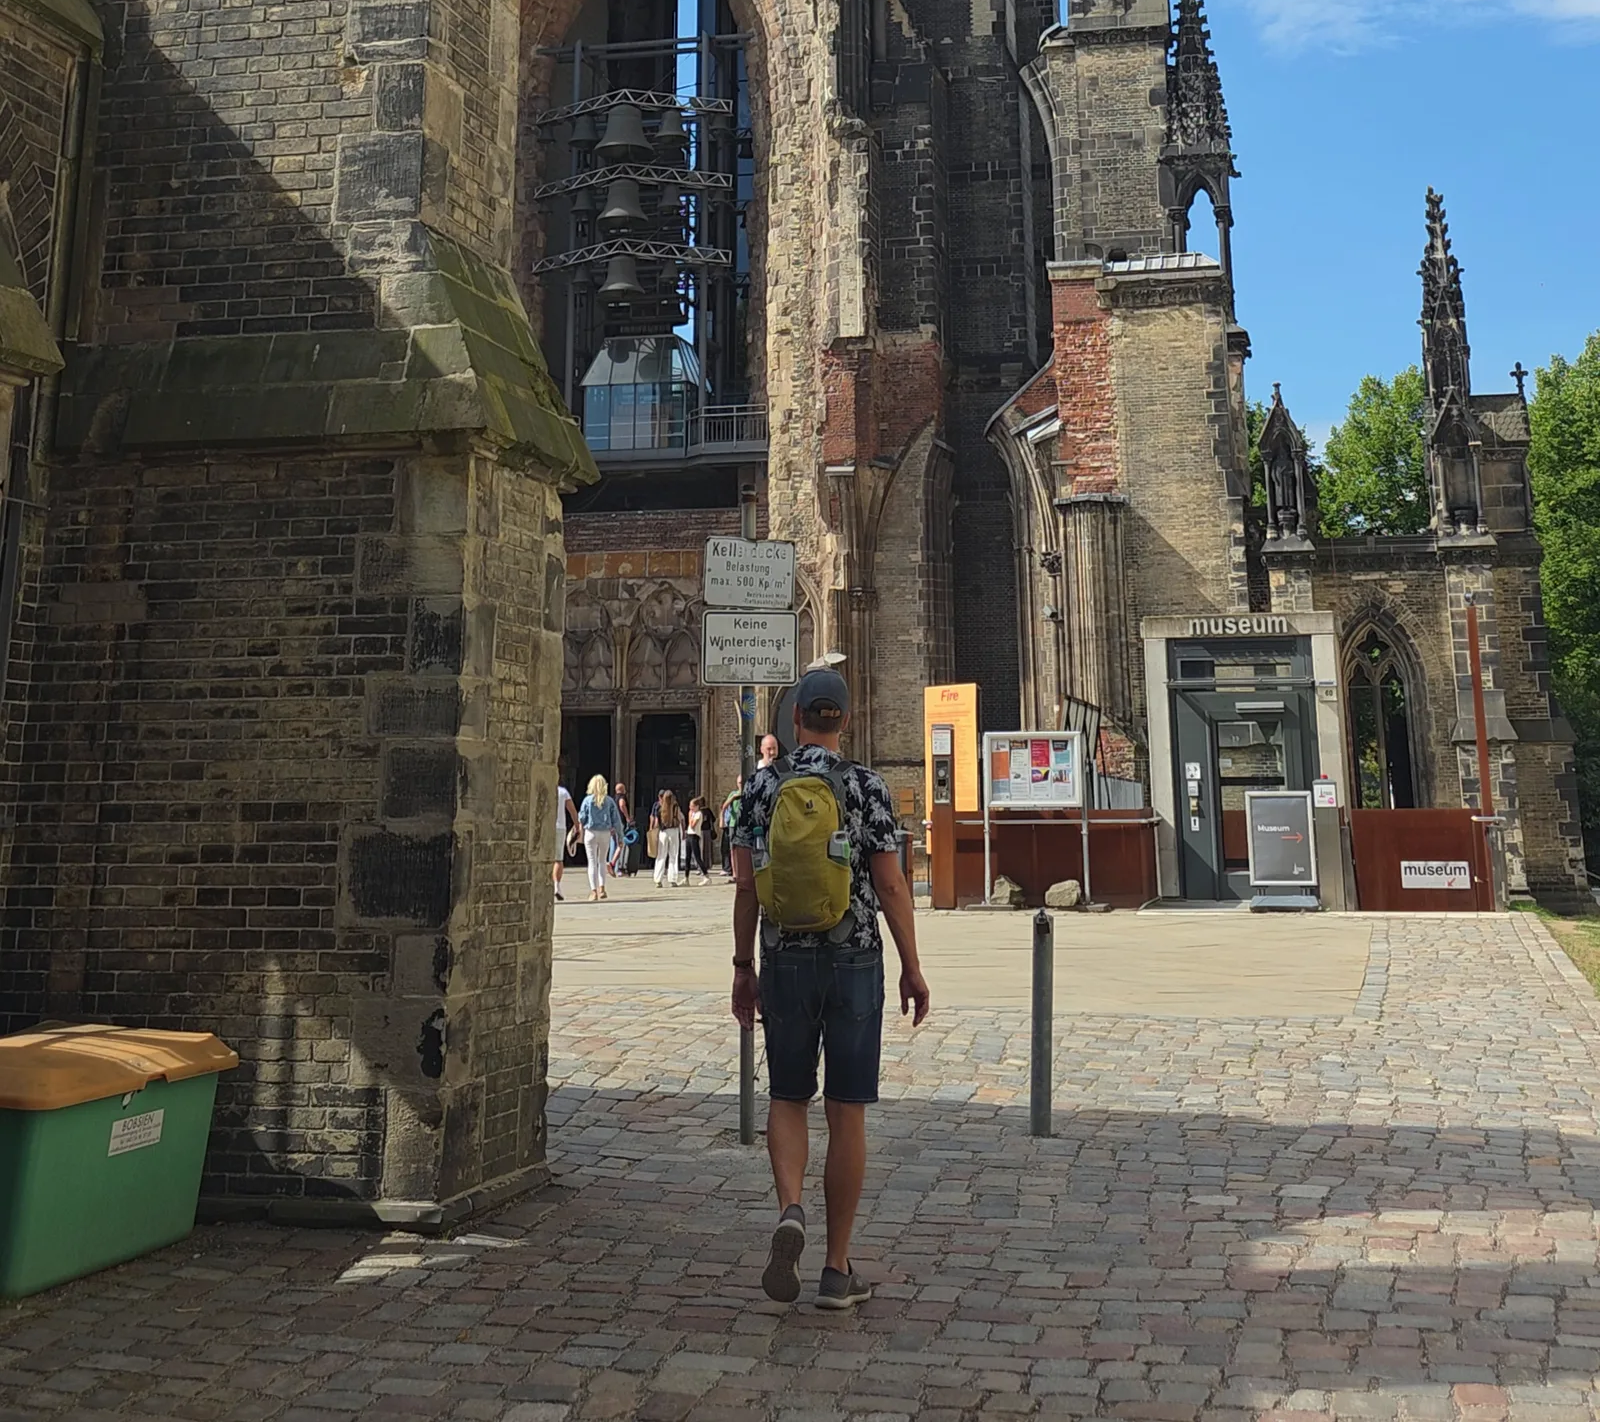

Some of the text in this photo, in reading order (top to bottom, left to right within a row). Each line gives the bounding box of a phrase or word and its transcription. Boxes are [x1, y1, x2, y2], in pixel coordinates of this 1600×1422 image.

[711, 577, 733, 586] max.
[736, 576, 754, 587] 500
[733, 618, 768, 630] Keine
[1189, 615, 1288, 636] museum
[709, 635, 792, 648] Winterdienst-
[721, 654, 779, 668] reinigung
[941, 689, 959, 702] Fire
[1257, 824, 1290, 832] Museum
[1403, 865, 1467, 876] museum
